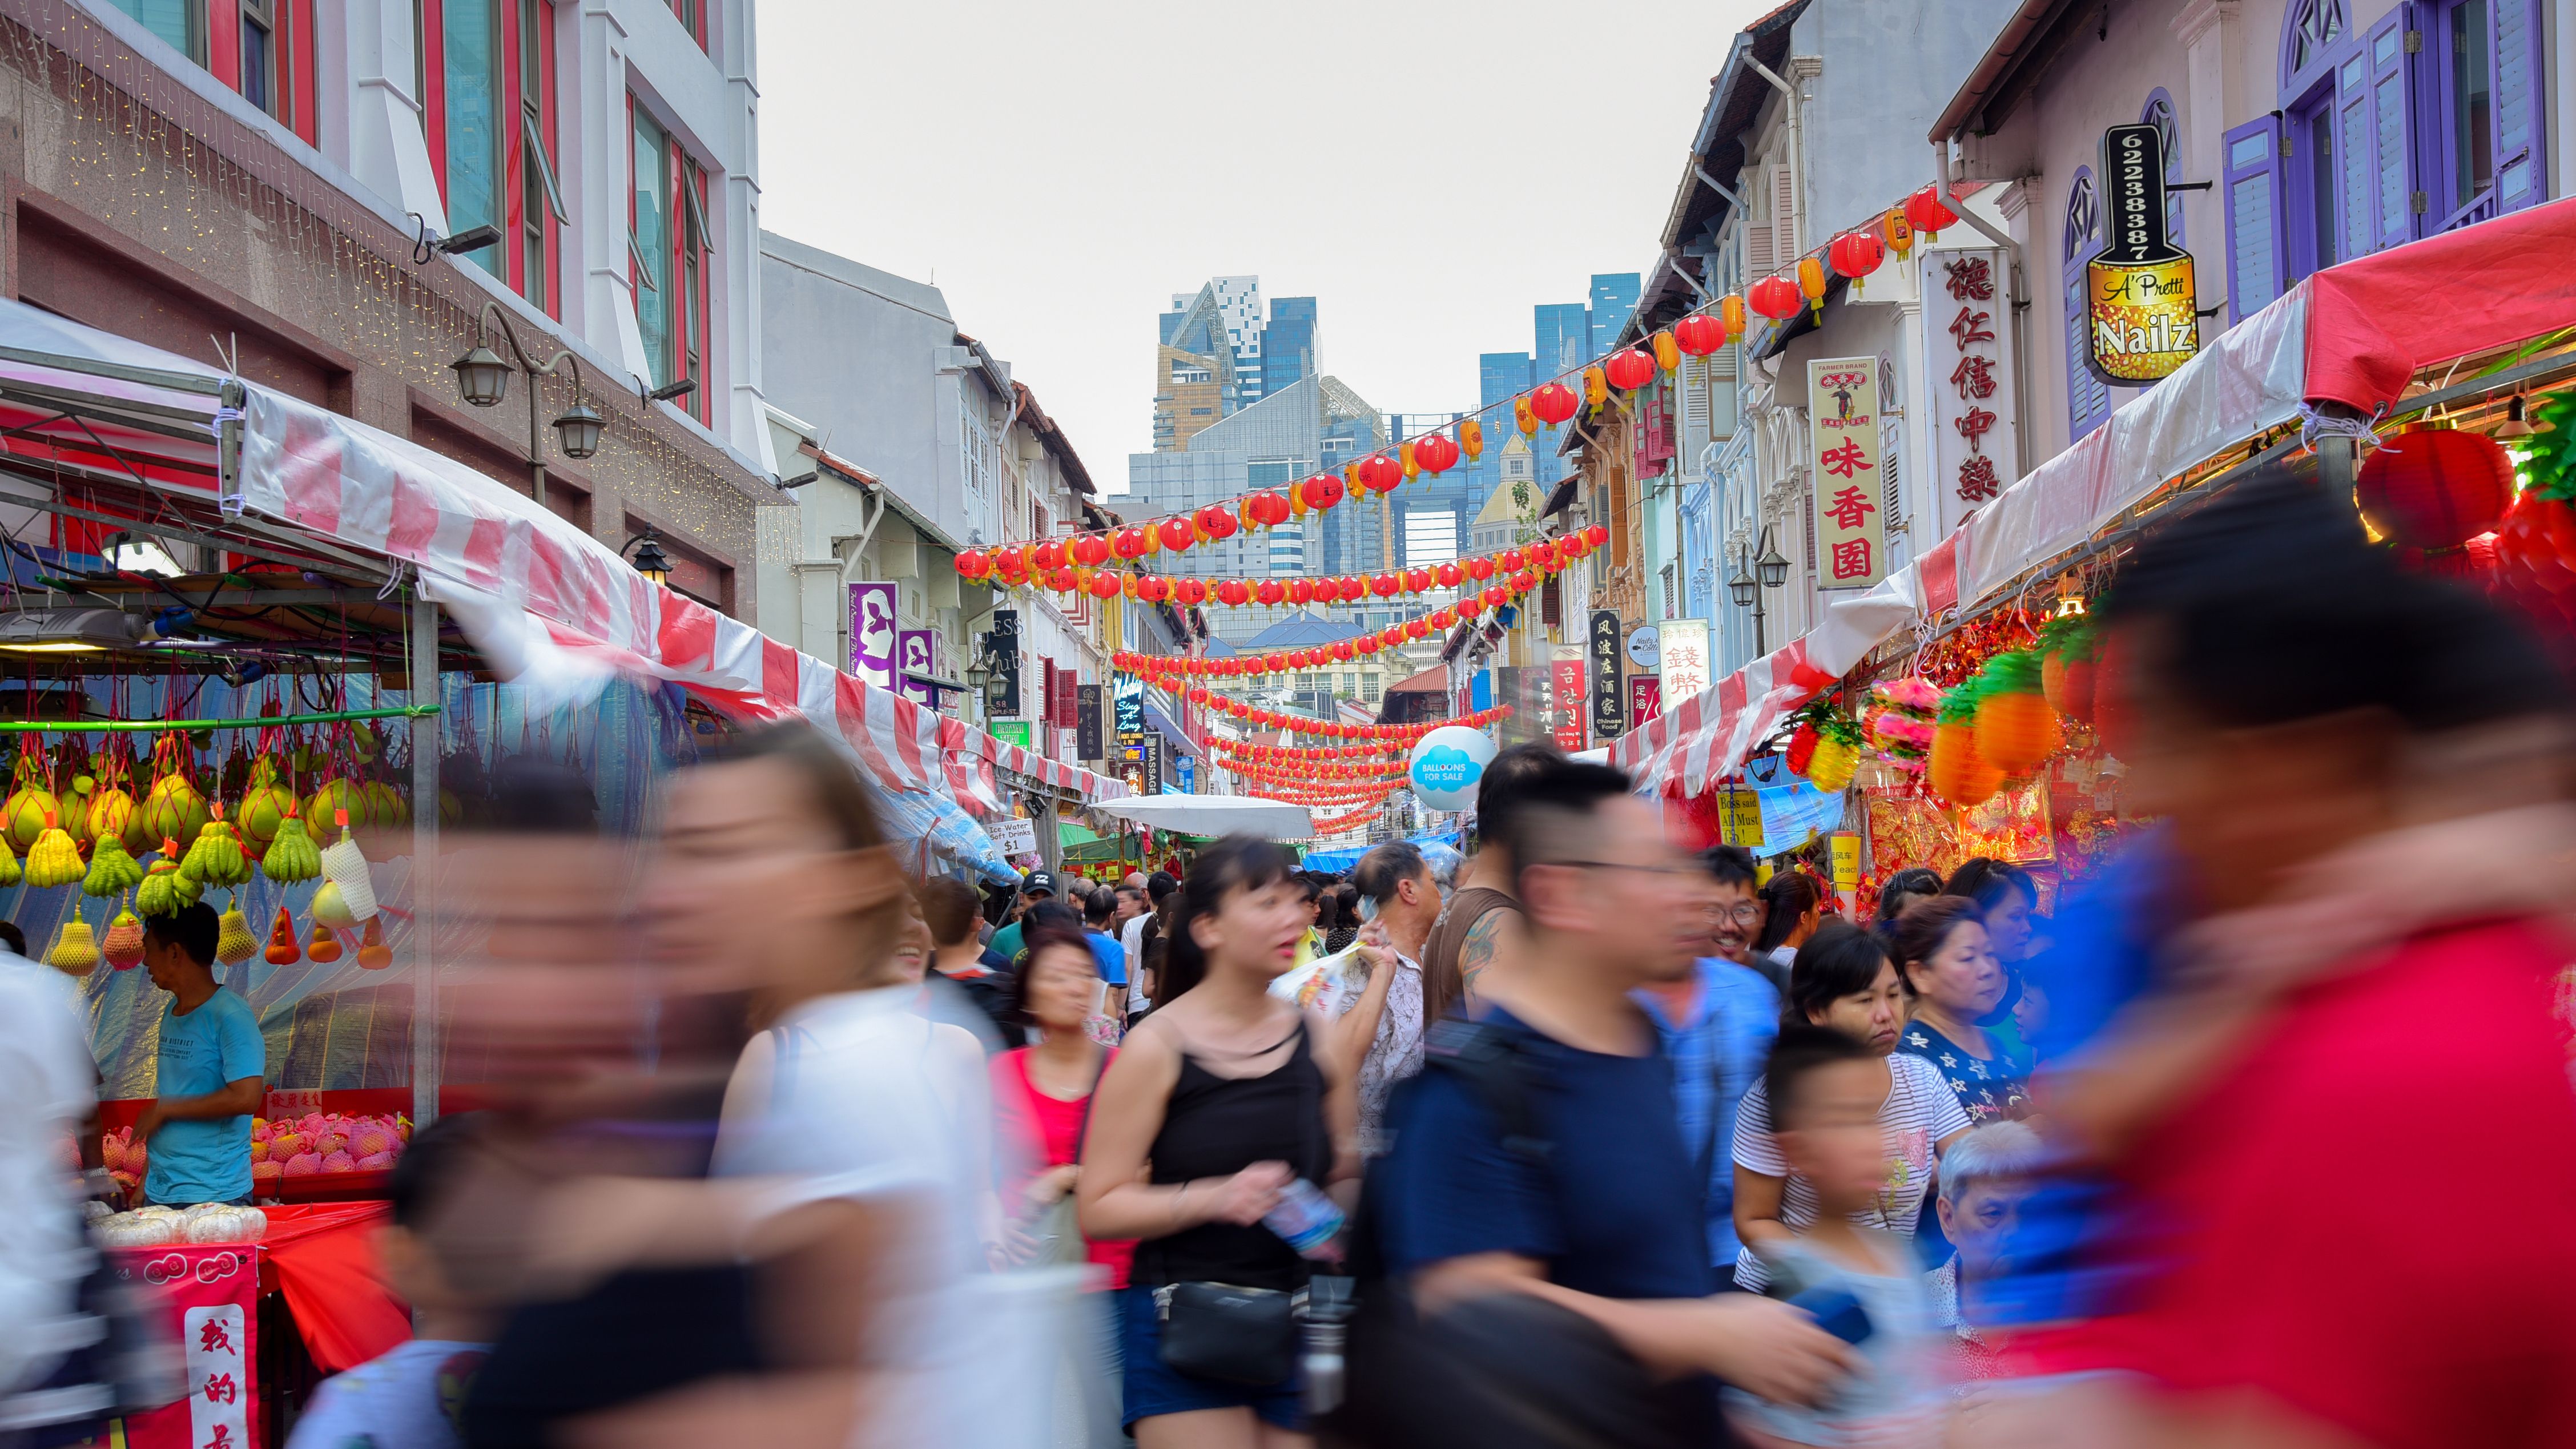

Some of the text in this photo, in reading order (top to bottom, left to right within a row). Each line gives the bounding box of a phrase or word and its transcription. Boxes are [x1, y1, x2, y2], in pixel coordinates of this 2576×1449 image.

[2122, 133, 2147, 260] 62238387
[2097, 314, 2193, 356] Nailz
[1635, 685, 1647, 710] 足浴
[996, 724, 1024, 734] HATYAI
[1000, 735, 1019, 744] THAI
[1148, 747, 1157, 794] MASSAGE
[1422, 763, 1466, 772] BALLOONS
[1442, 772, 1463, 781] SALE
[1742, 797, 1757, 808] said
[1737, 814, 1759, 827] Must
[1008, 830, 1031, 838] Drinks
[1004, 839, 1019, 852] $1
[1840, 865, 1857, 874] each
